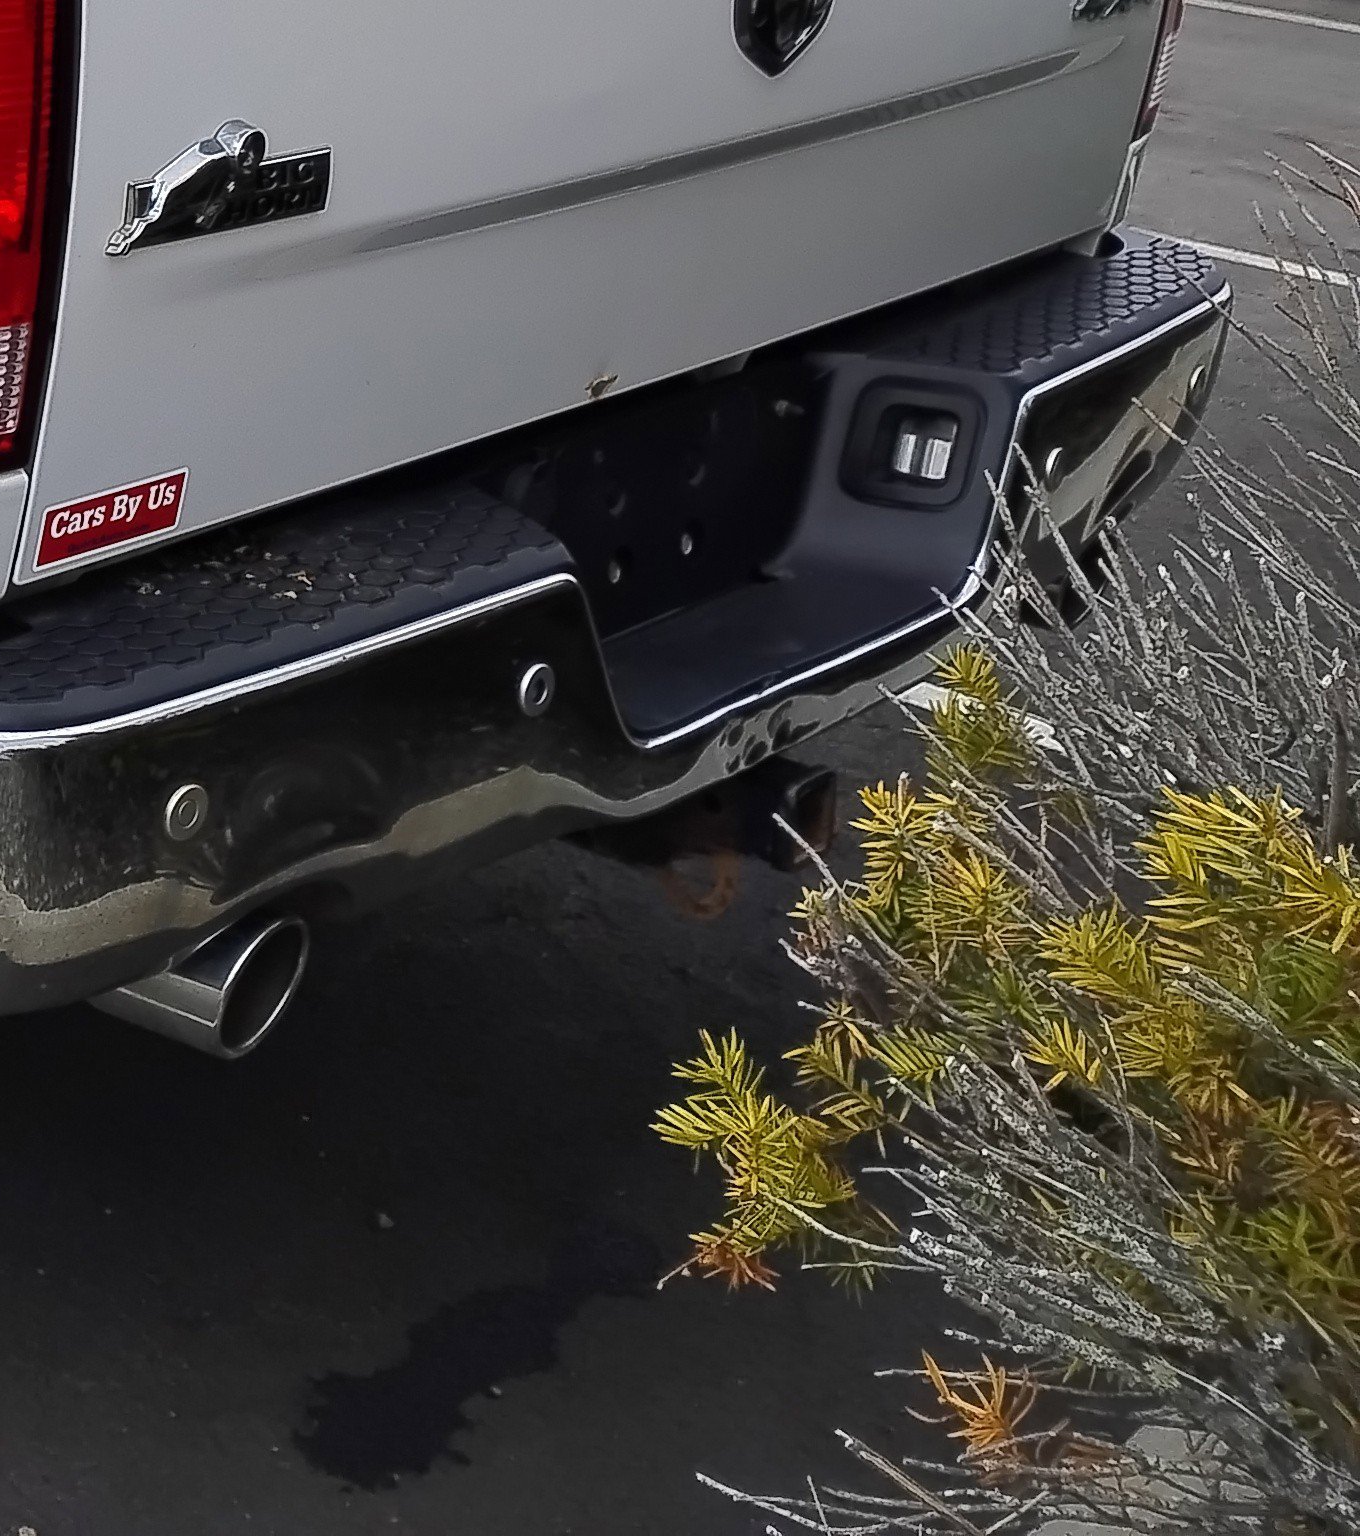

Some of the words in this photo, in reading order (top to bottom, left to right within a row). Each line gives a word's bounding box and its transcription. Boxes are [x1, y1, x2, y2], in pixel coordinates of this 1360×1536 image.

[50, 504, 107, 539] Cars
[109, 493, 144, 523] By
[147, 481, 177, 510] Us
